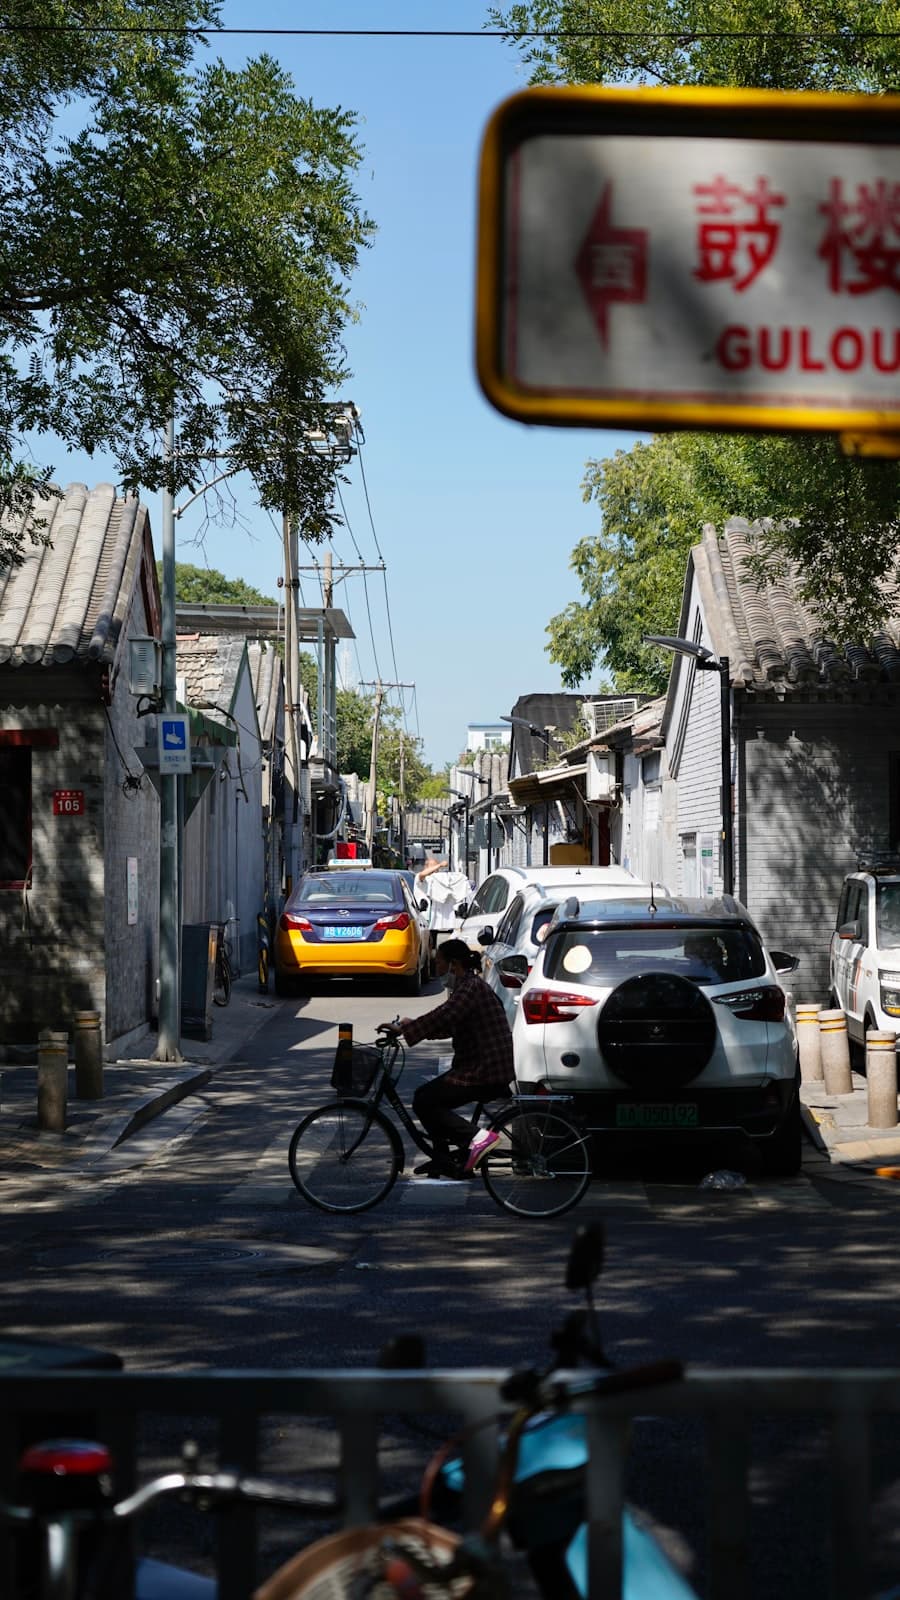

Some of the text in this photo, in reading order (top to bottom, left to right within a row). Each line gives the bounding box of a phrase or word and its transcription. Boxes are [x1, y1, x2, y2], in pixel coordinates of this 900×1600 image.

[691, 173, 900, 296] 鼓楼
[716, 325, 900, 374] GULOU
[58, 800, 79, 812] 105
